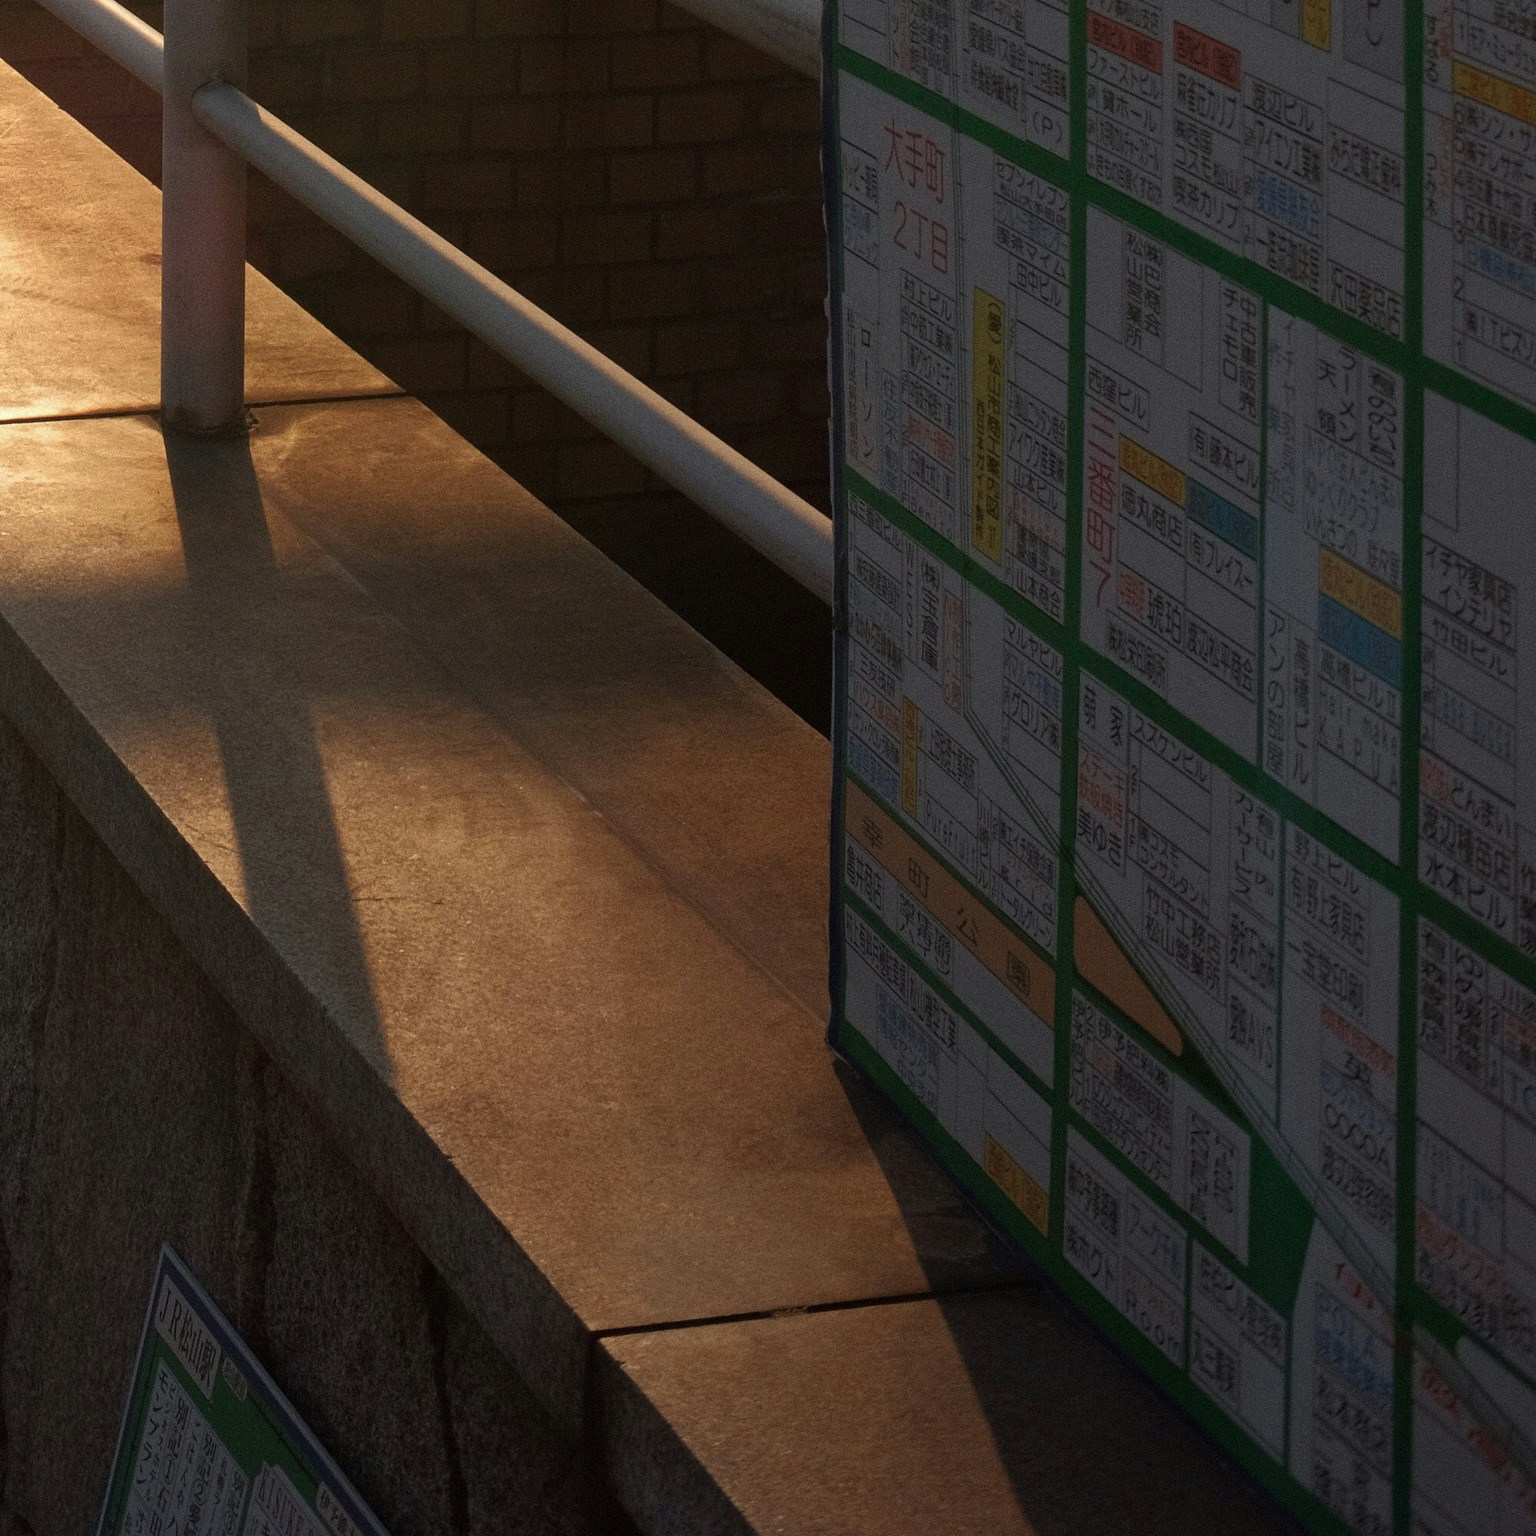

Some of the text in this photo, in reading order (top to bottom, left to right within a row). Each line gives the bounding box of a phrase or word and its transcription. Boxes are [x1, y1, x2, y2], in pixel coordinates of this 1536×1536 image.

[1089, 46, 1159, 103] ファーストビル
[883, 112, 945, 208] 大手町
[892, 193, 948, 280] 2丁目
[903, 270, 951, 325] 村上ビル
[1016, 260, 1061, 311] 田中ビル
[860, 324, 873, 465] ローソン
[1088, 362, 1145, 424] 西窪ビル
[1238, 292, 1256, 420] 中古車販売
[1338, 344, 1356, 451] ラーメン
[1014, 460, 1058, 515] 山本ビル
[1121, 477, 1182, 553] 徳丸商店
[1016, 562, 1060, 623] 山本商会
[1005, 615, 1061, 680] マルヤビル
[1432, 613, 1506, 684] 竹田ビル
[1267, 606, 1285, 781] アンの部屋
[1293, 633, 1308, 792] 高橋ビル
[1080, 742, 1124, 804] ステーキ
[1135, 711, 1206, 788] スズケンビル
[1078, 802, 1121, 873] 美ゆき
[1295, 828, 1358, 903] 野上ビル
[1146, 879, 1220, 973] 竹中工務店
[1425, 843, 1508, 941] 水本ビル
[1145, 906, 1220, 1002] 松山営業所
[157, 1280, 218, 1390] JR松山駅
[135, 1366, 169, 1492] モンブラン
